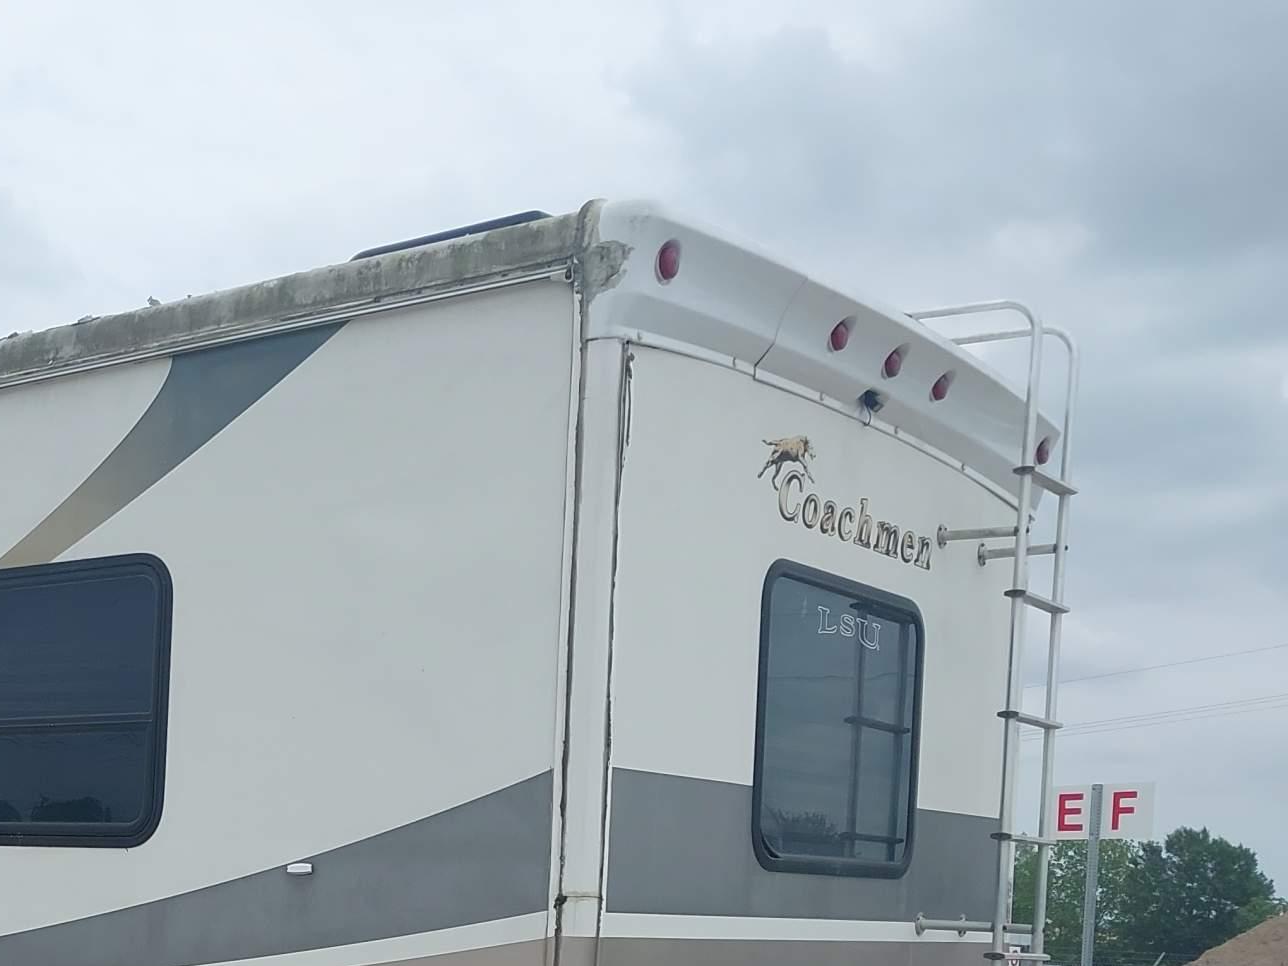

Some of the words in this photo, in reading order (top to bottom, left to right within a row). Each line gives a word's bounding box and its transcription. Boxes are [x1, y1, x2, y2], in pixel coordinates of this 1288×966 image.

[778, 469, 933, 570] Coachmen
[817, 605, 881, 651] LSU
[1057, 793, 1084, 832] E
[1111, 791, 1138, 830] F
